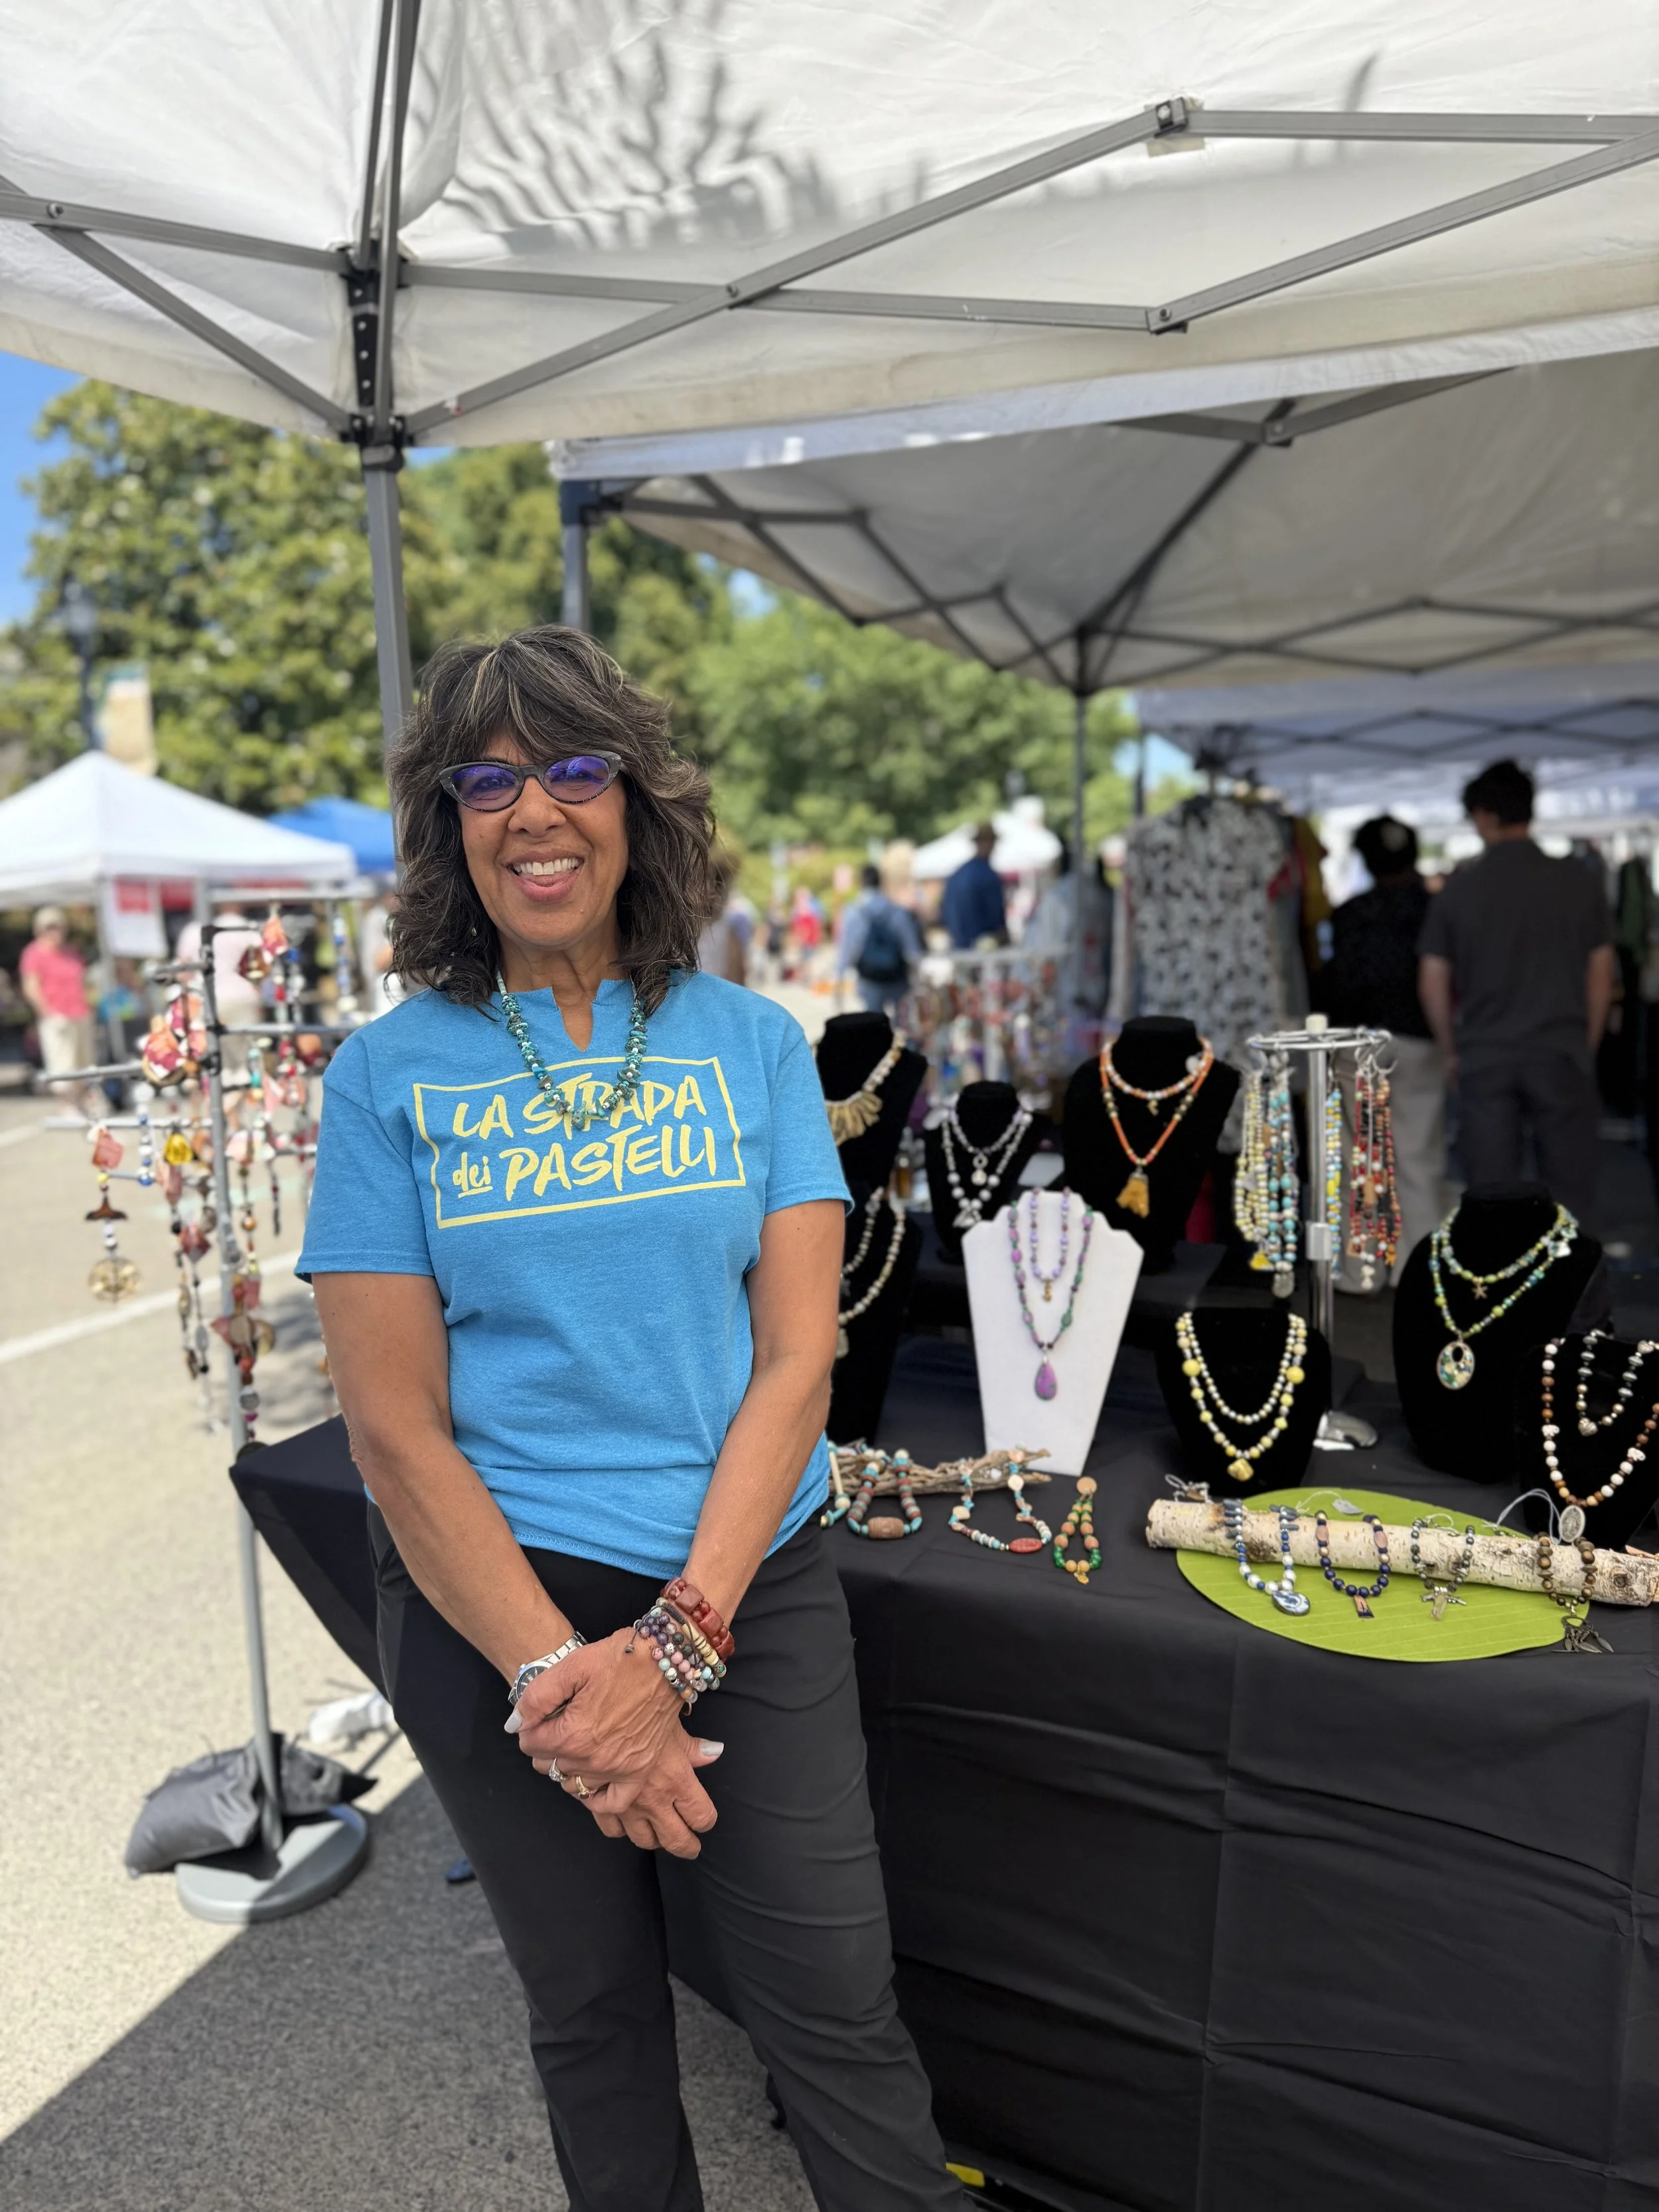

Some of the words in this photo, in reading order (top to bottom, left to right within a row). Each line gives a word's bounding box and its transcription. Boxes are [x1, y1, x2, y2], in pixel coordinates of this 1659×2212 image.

[453, 1094, 514, 1140] LA
[523, 1072, 707, 1140] STRADA
[453, 1151, 492, 1193] dei
[499, 1124, 717, 1201] PASTELLI
